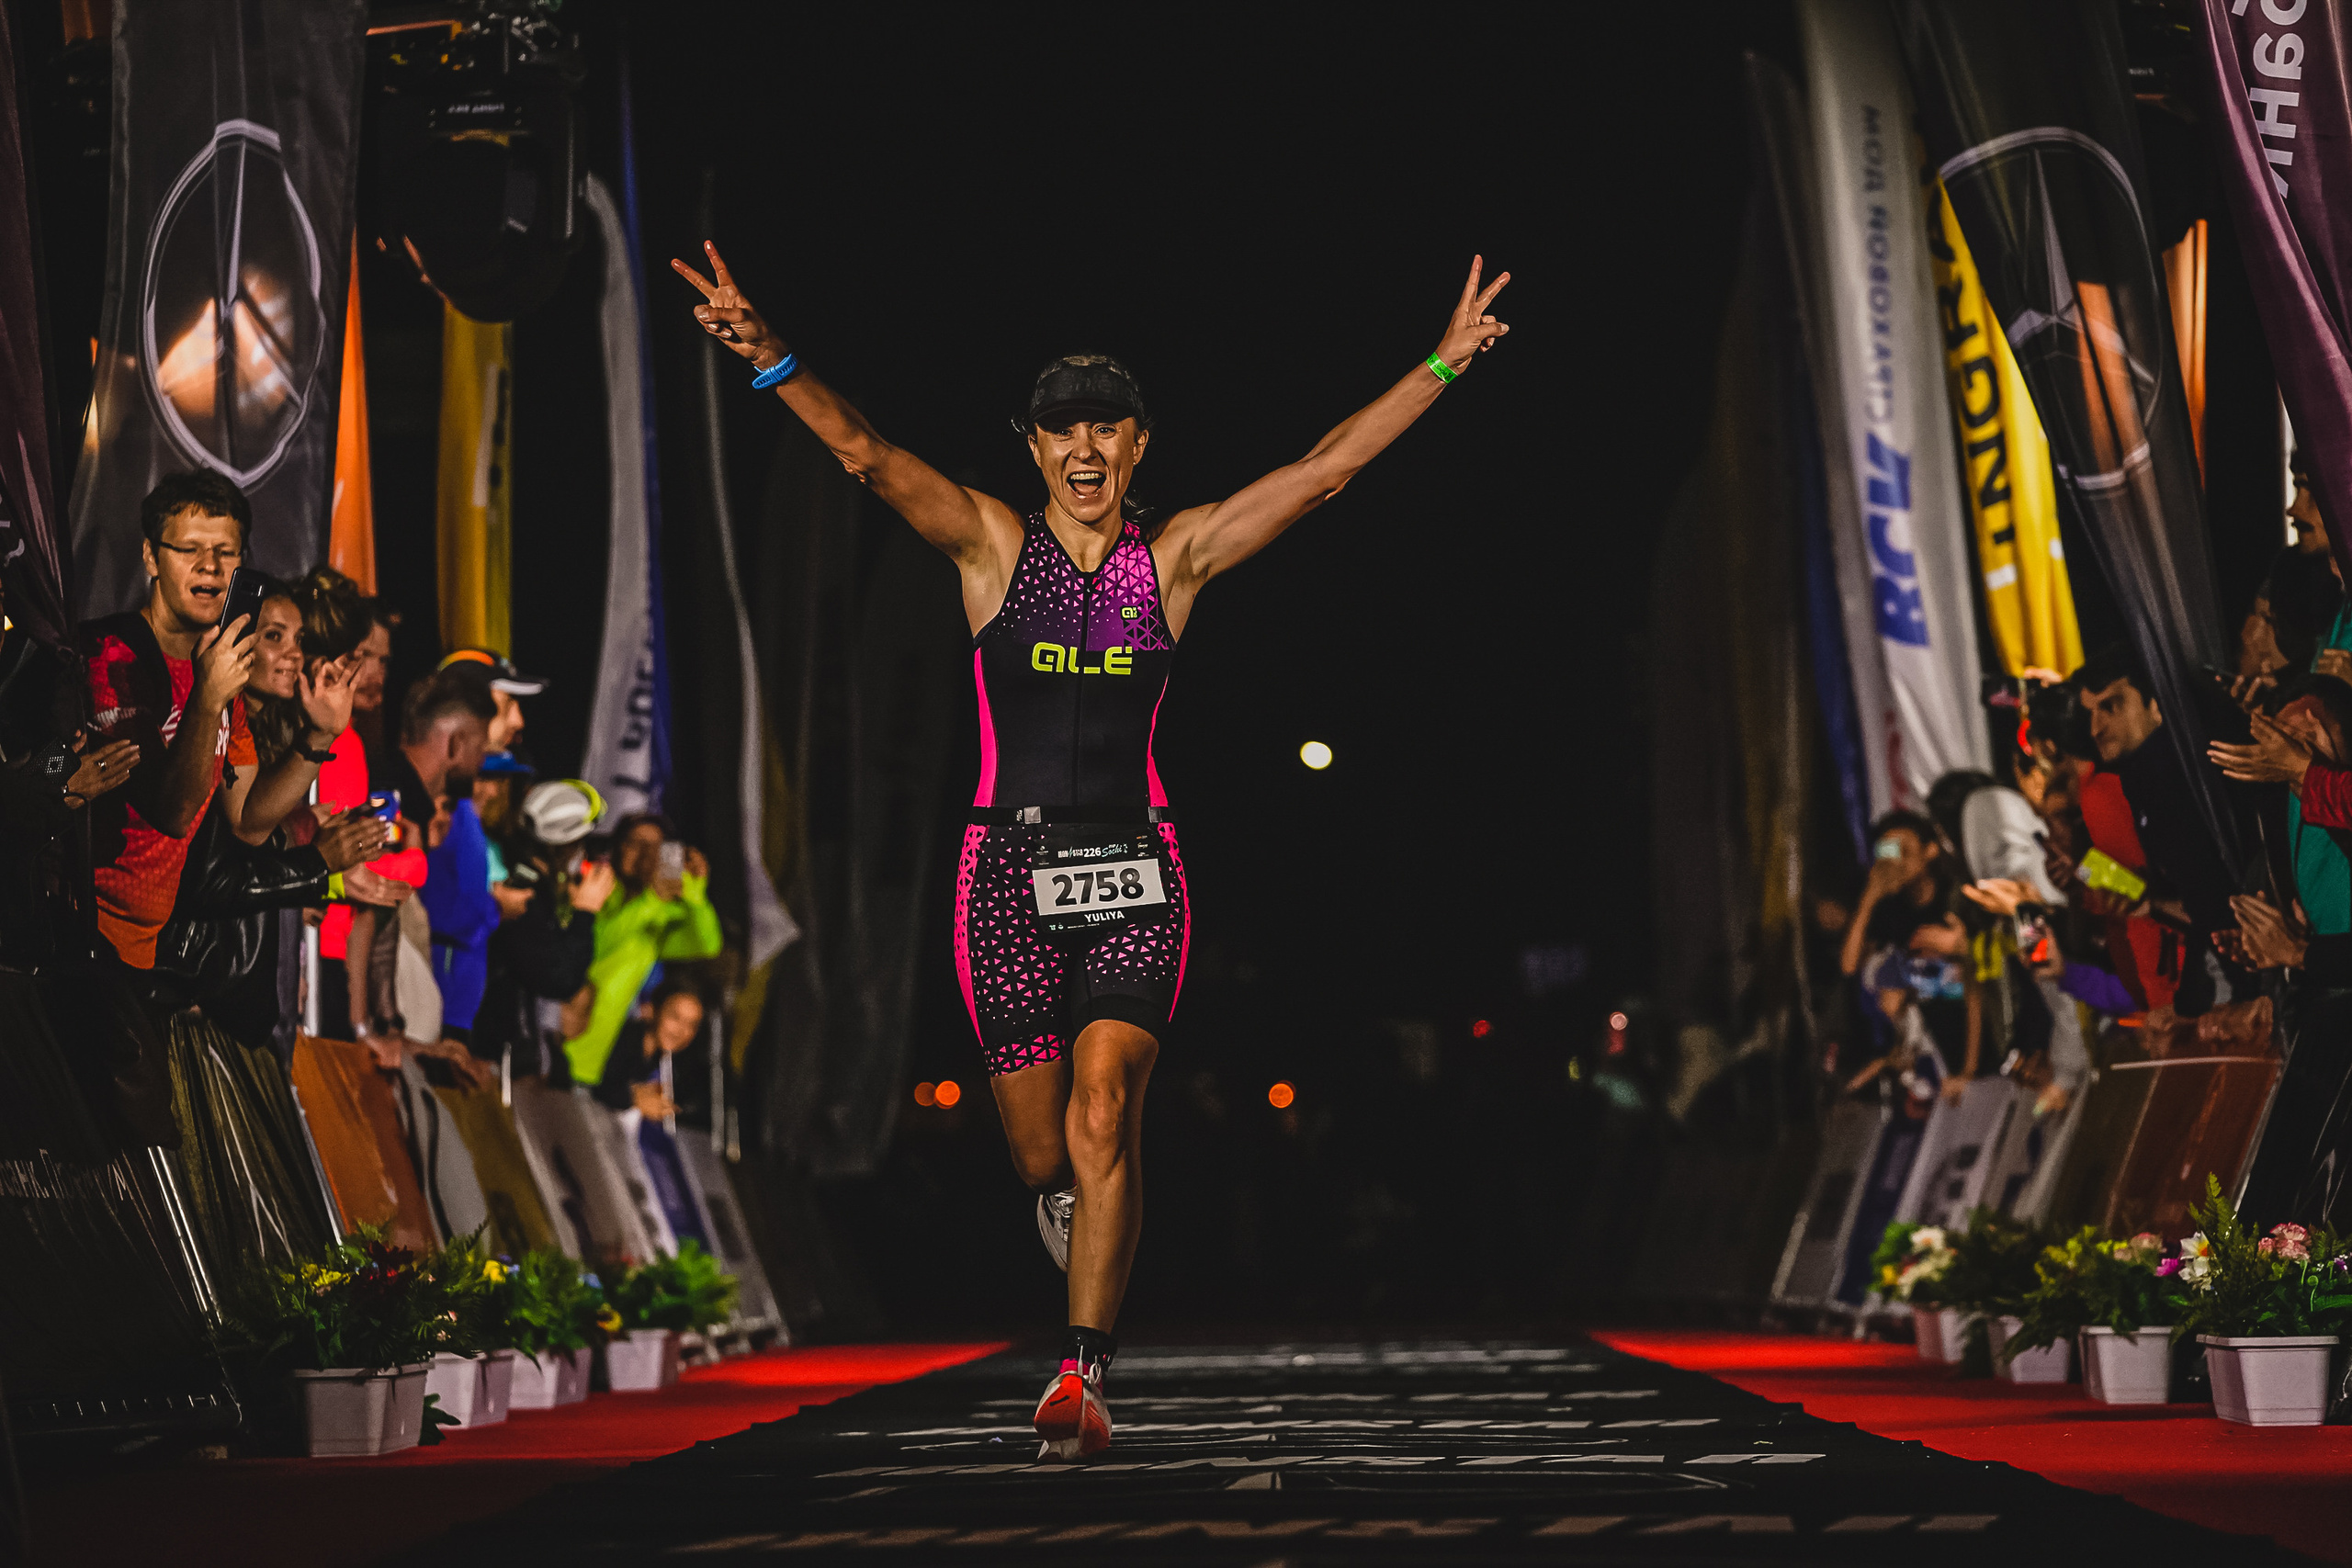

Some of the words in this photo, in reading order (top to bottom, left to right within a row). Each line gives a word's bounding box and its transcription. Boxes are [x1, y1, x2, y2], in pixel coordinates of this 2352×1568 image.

[1083, 847, 1102, 858] 226
[1052, 868, 1144, 907] 2758
[1084, 910, 1125, 923] YULIYA
